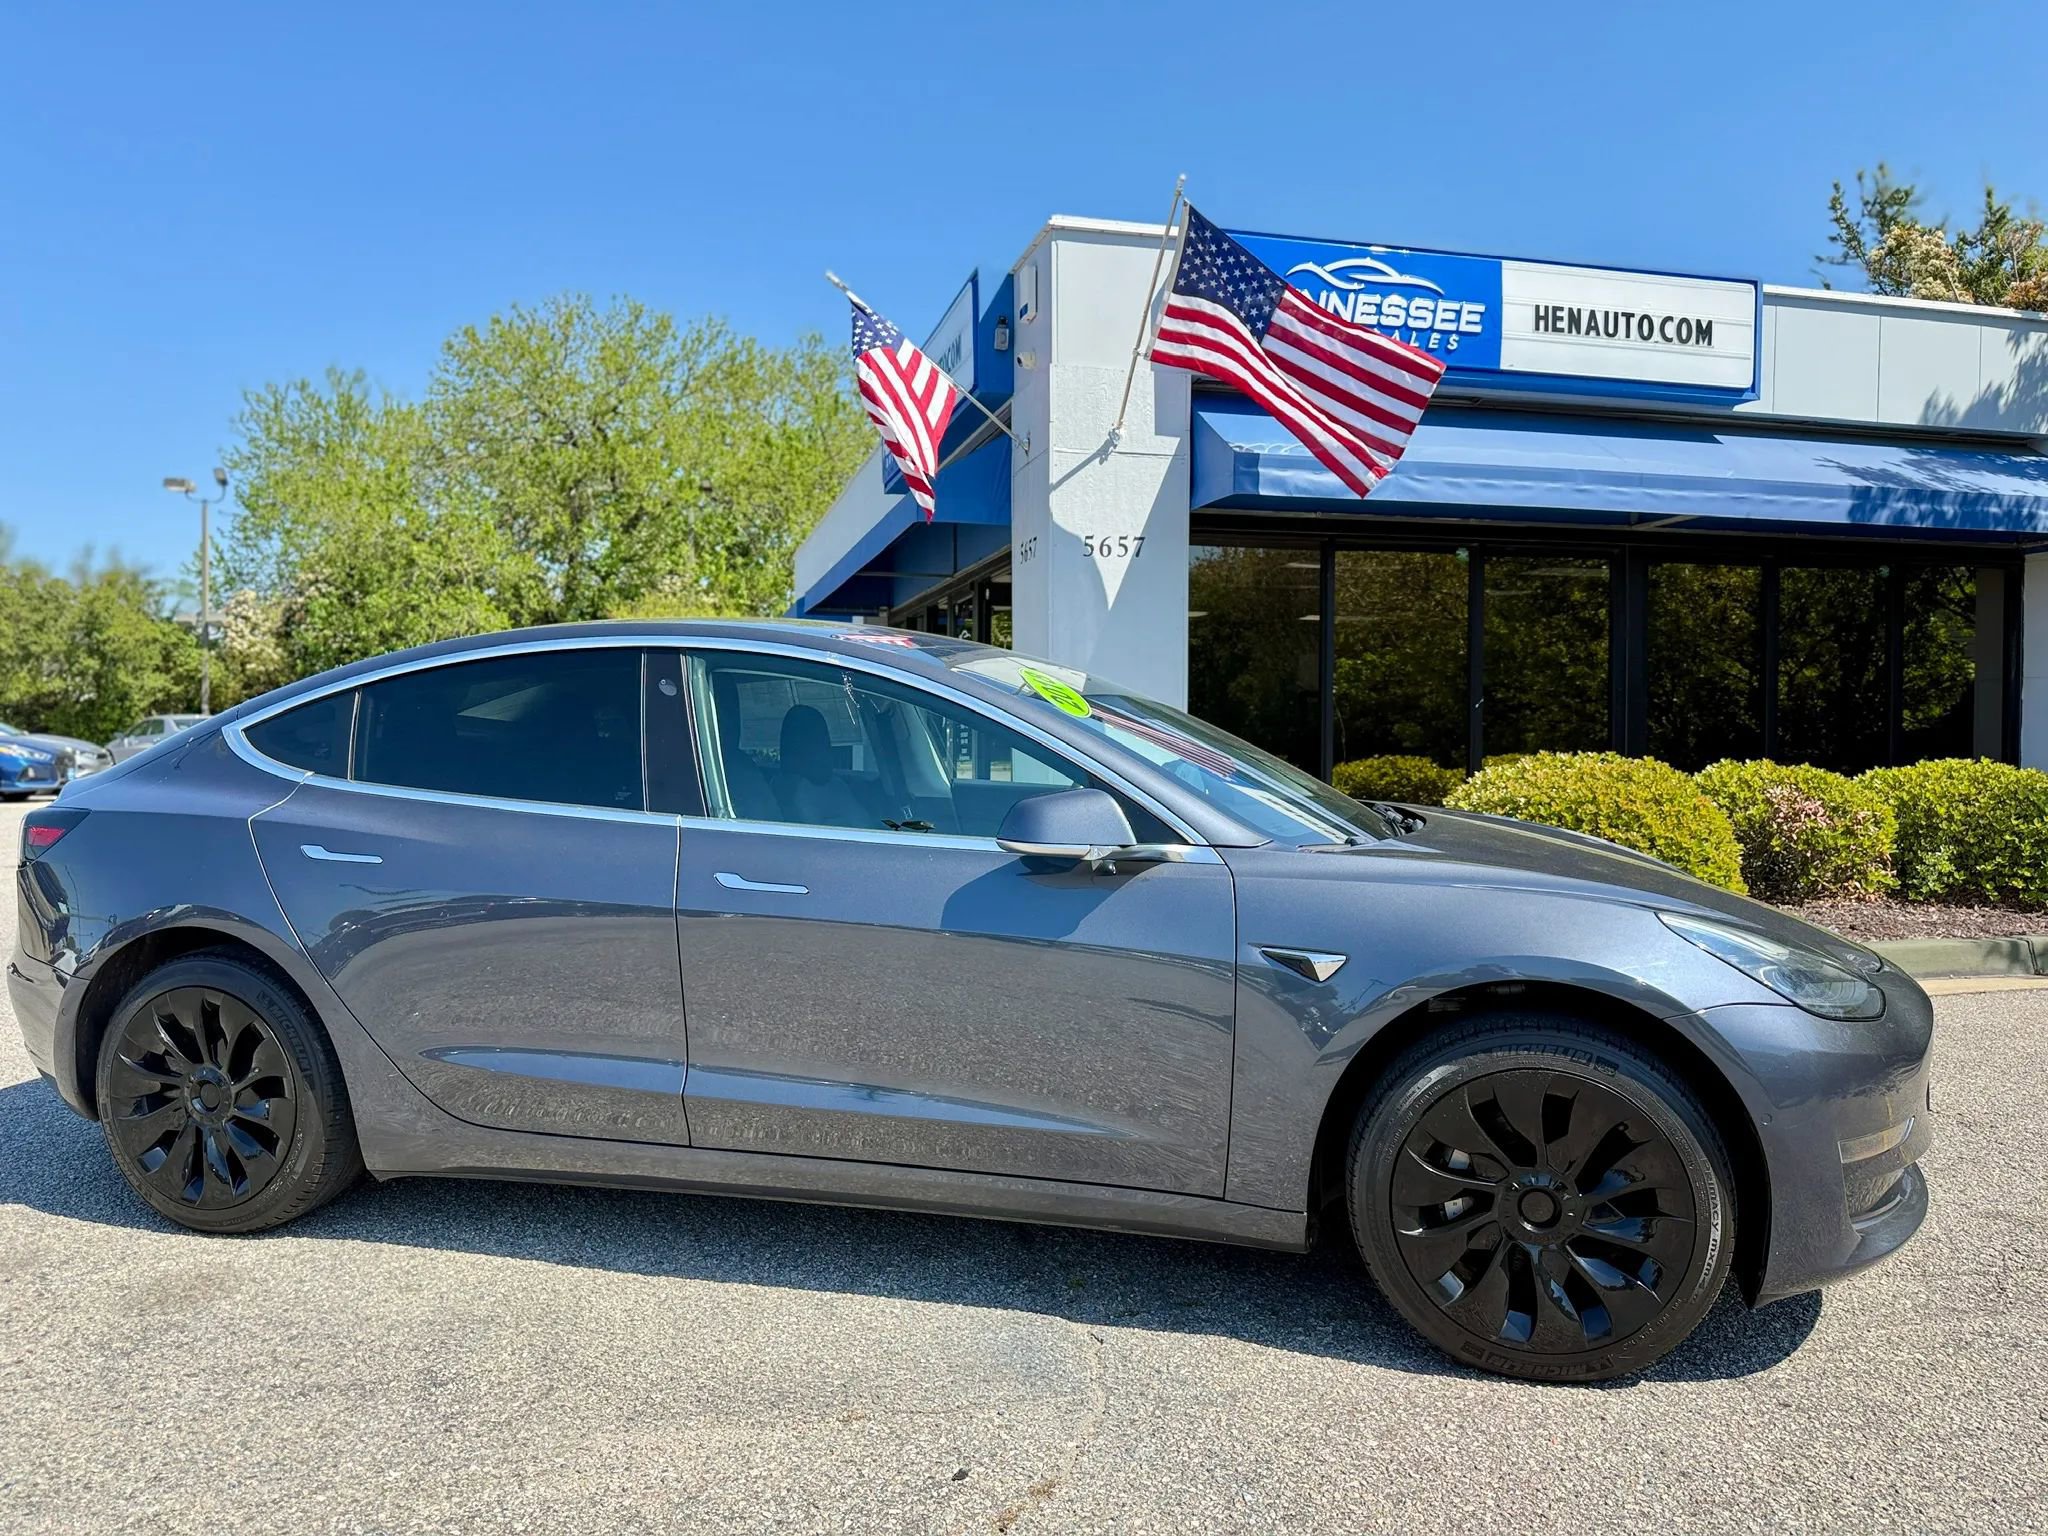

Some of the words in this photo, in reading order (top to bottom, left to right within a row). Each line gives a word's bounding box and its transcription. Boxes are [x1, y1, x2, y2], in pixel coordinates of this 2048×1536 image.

[1296, 288, 1486, 333] NESSEE
[1374, 328, 1460, 350] ALES
[1019, 536, 1038, 564] 5657
[1083, 534, 1146, 558] 5657
[268, 1003, 312, 1073] MICHELIN
[1491, 1043, 1592, 1066] MICHELIN
